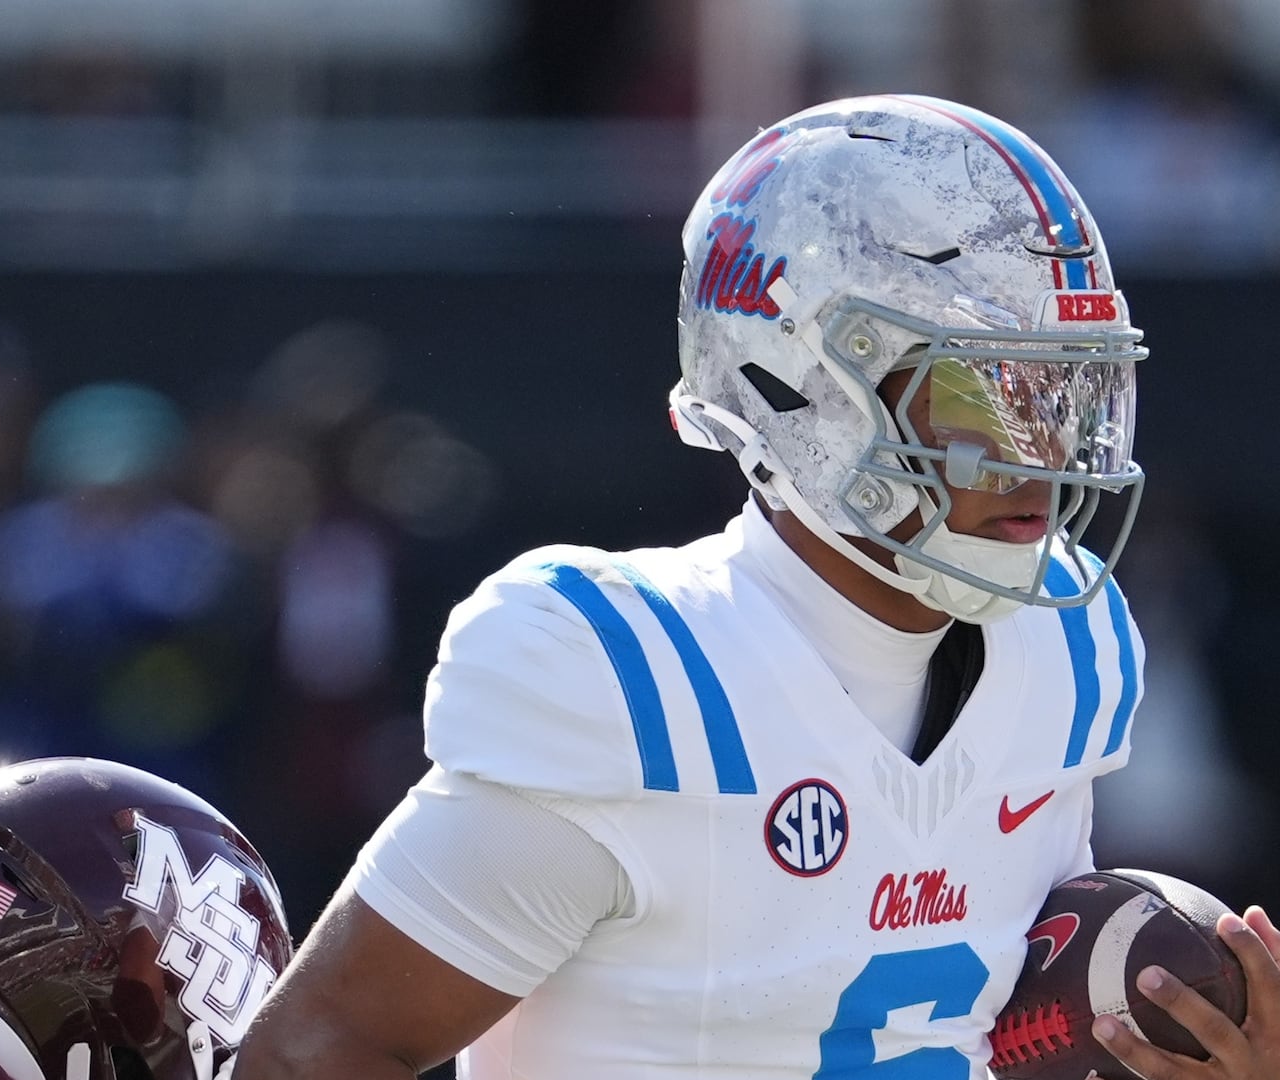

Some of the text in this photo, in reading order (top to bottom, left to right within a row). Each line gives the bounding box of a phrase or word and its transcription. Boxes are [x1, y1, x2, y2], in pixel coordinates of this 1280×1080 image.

[1056, 294, 1116, 321] REBS
[772, 786, 843, 870] SEC
[870, 868, 967, 931] Ole Miss
